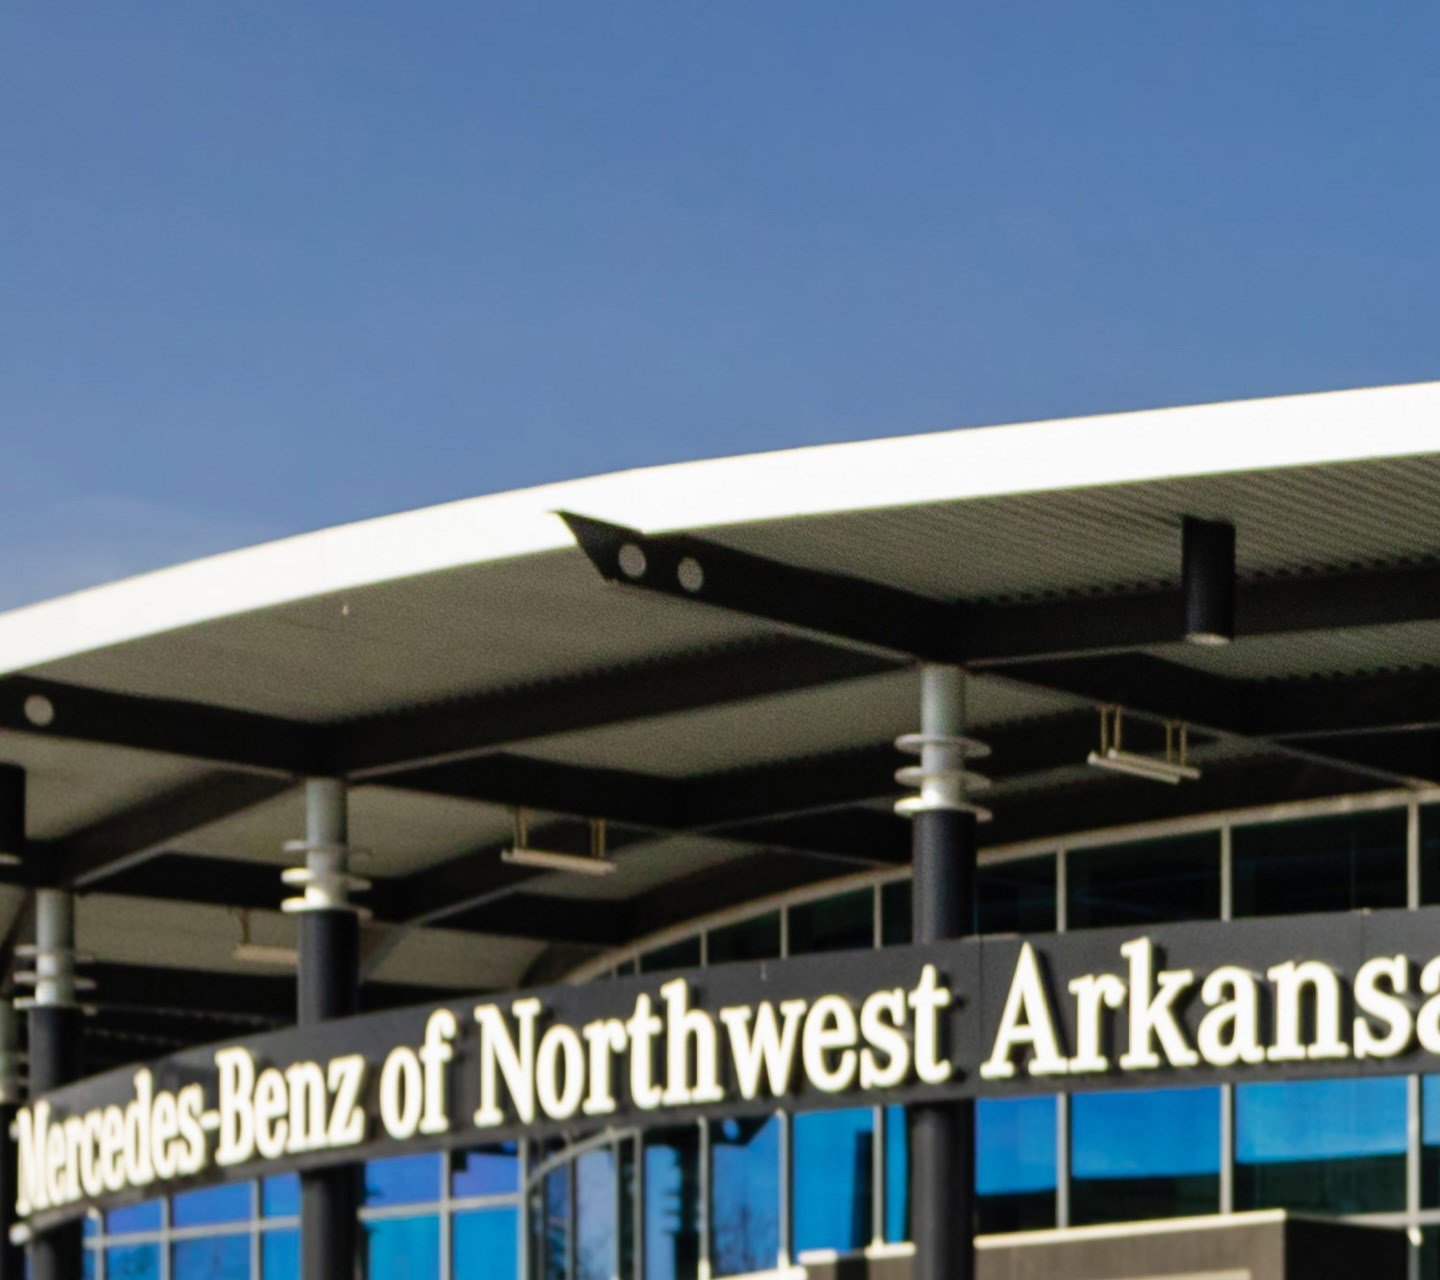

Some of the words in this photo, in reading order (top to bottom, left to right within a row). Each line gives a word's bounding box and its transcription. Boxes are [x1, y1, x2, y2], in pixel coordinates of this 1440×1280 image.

[14, 1045, 367, 1215] Mercedes-Benz
[379, 1007, 457, 1140] of
[474, 965, 951, 1128] Northwest
